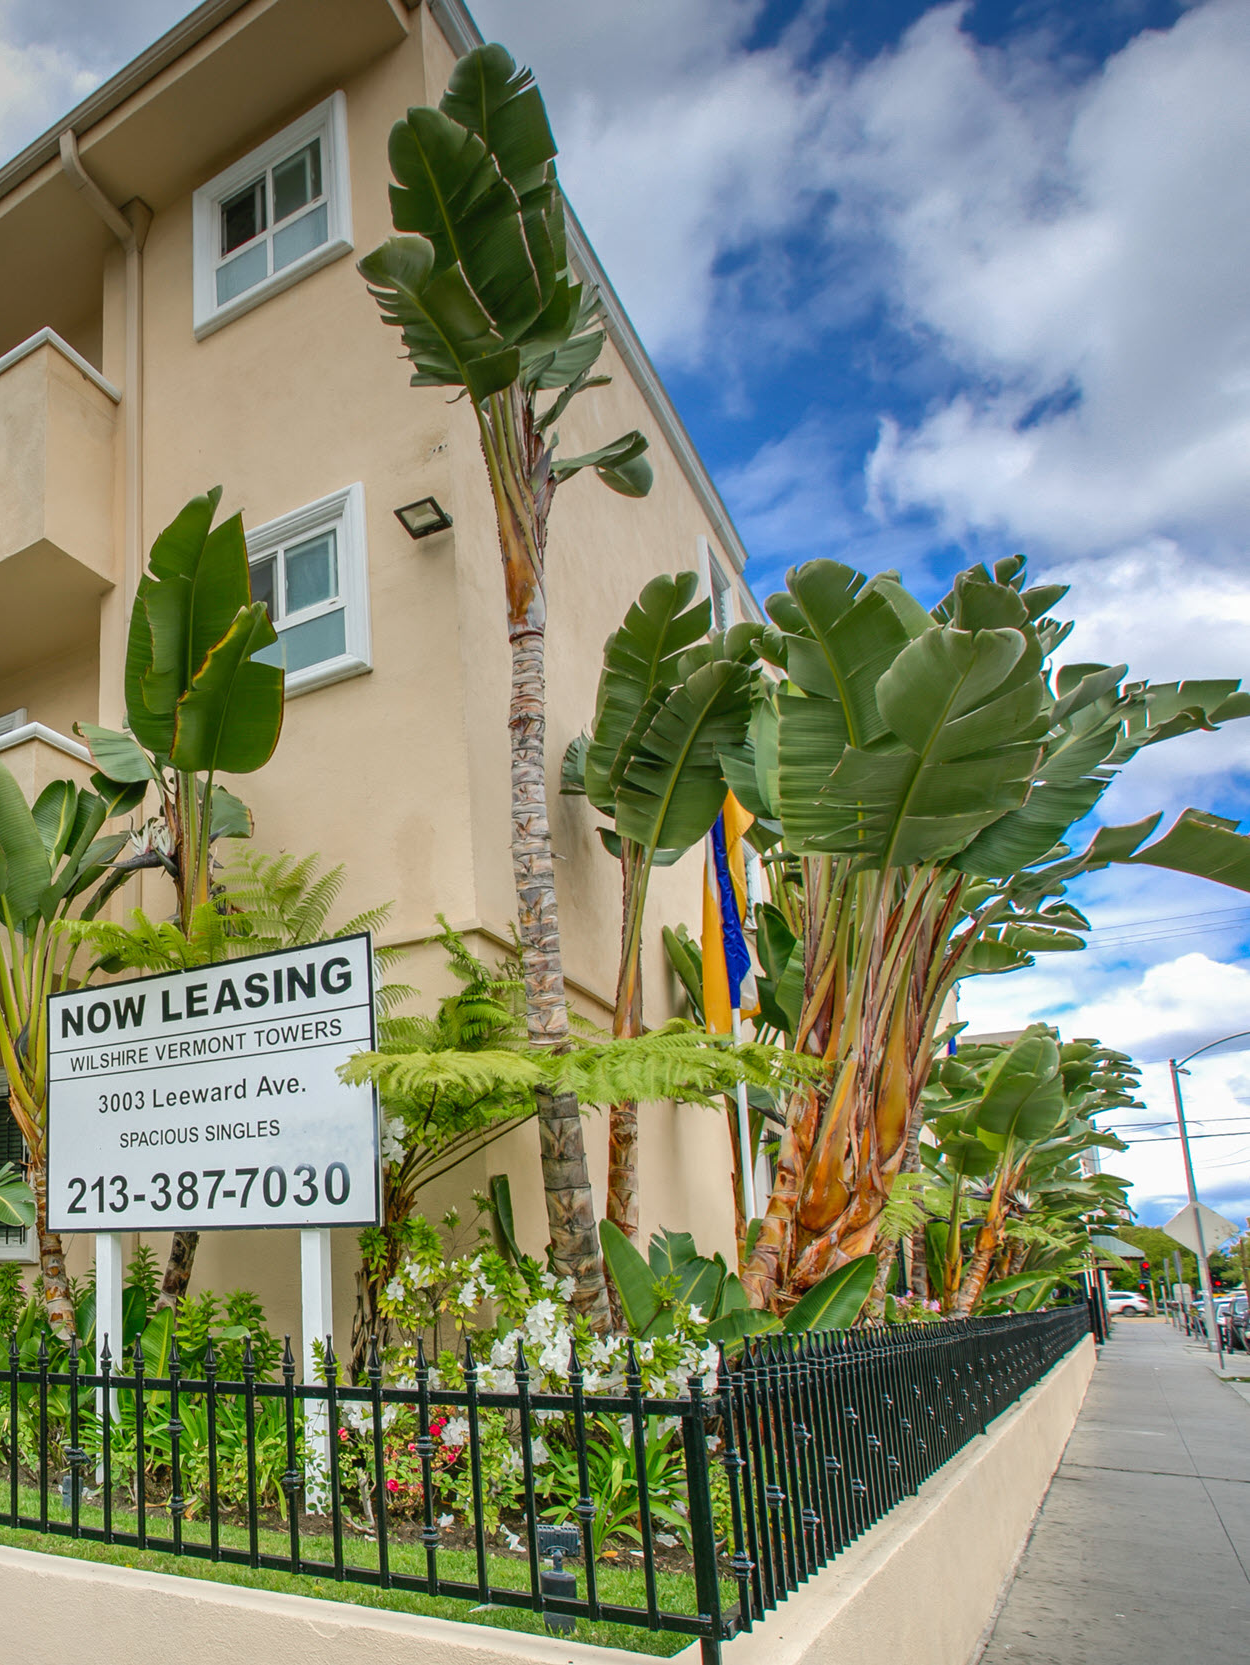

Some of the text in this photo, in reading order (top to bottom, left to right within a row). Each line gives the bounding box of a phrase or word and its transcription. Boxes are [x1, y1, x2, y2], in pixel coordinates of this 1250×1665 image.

[61, 956, 352, 1039] NOW LEASING
[70, 1018, 342, 1073] WILSHIRE VERMONT TOWERS
[98, 1075, 306, 1114] 3003 Leeward Ave.
[119, 1119, 280, 1149] SPACIOUS SINGLES
[66, 1162, 351, 1214] 213-387-7030
